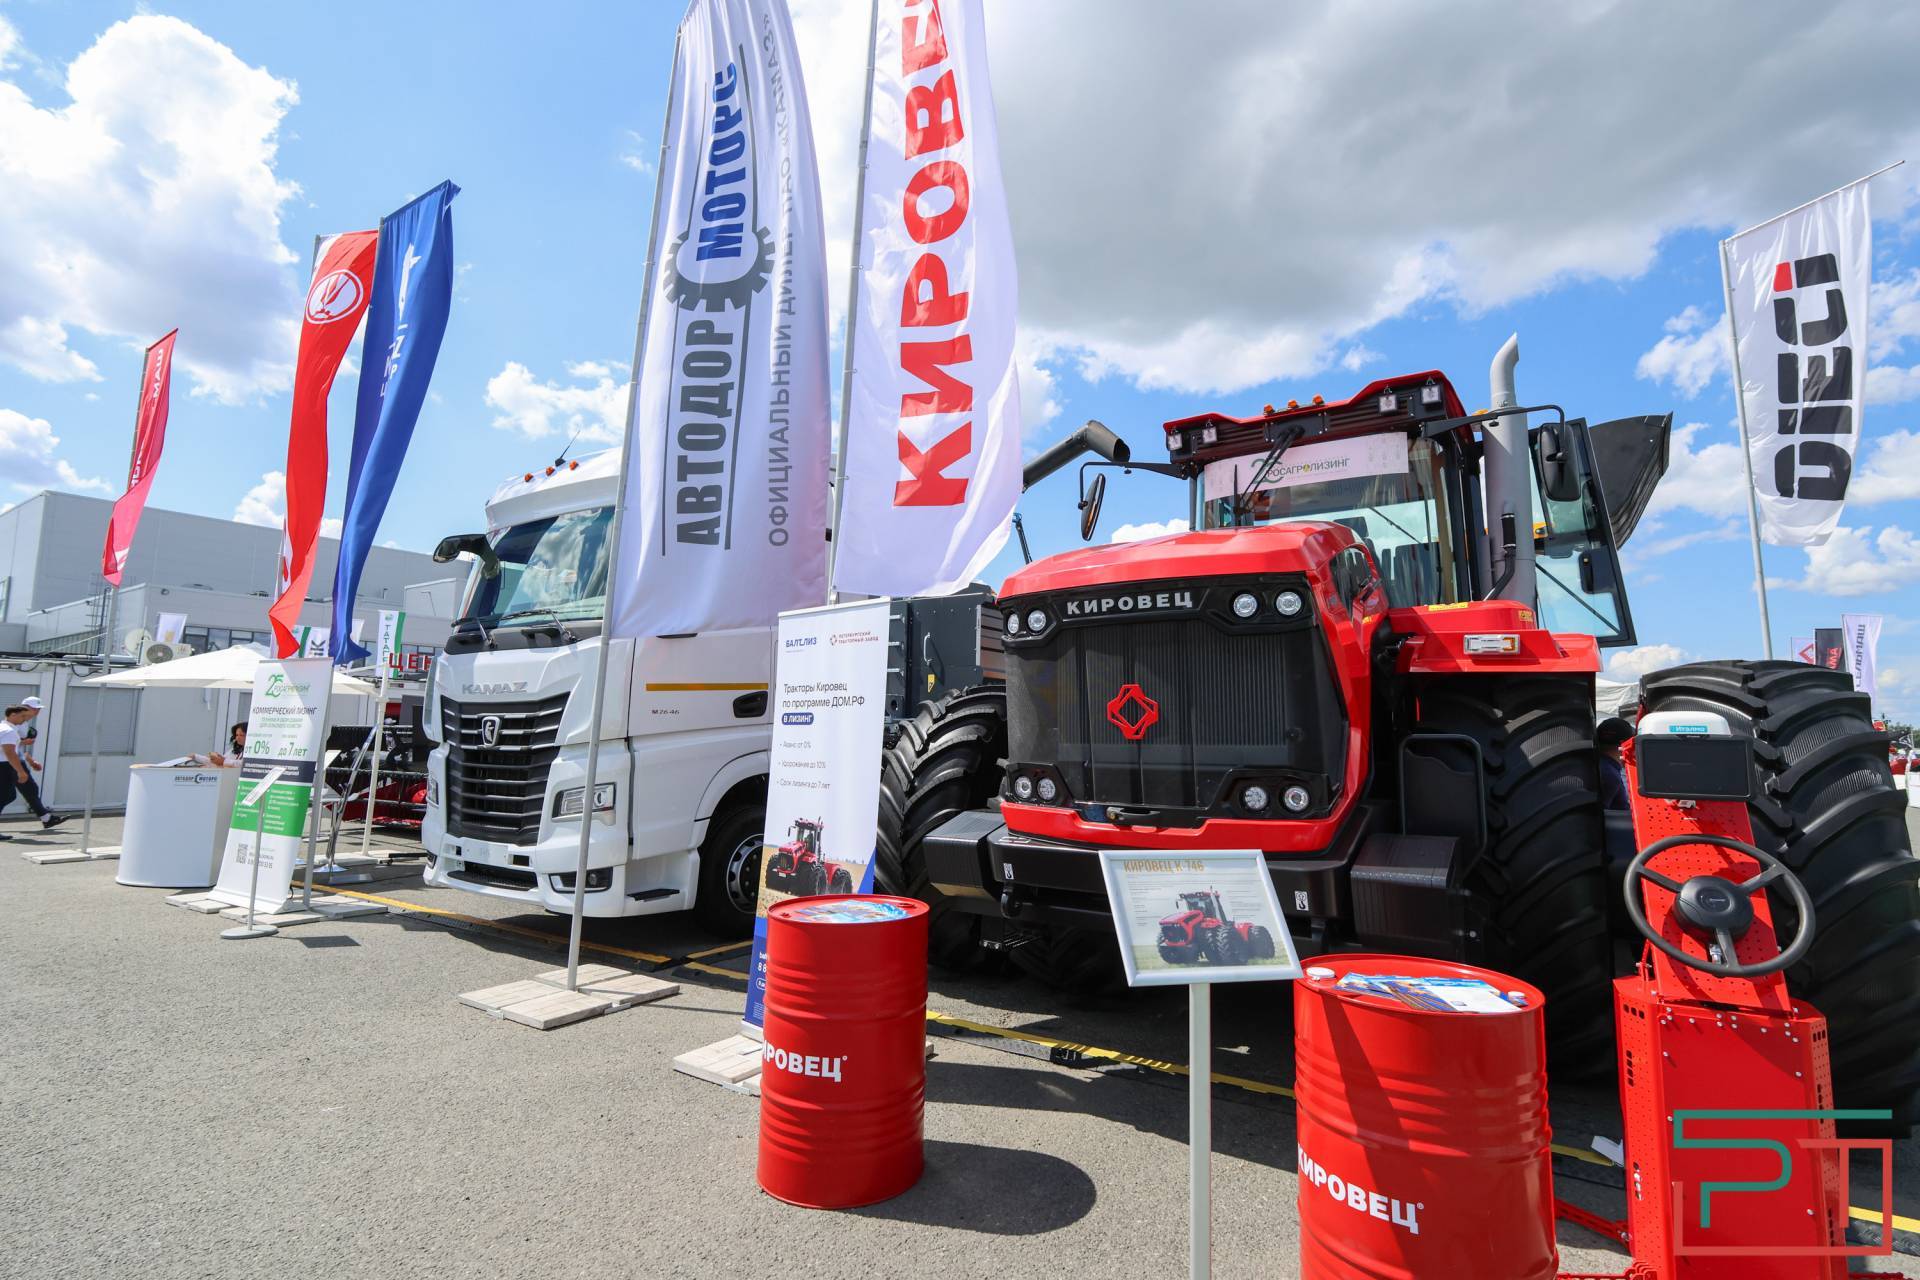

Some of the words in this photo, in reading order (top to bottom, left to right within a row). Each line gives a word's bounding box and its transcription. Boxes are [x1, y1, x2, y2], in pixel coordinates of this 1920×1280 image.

[695, 61, 747, 262] МОТОРС
[893, 0, 973, 507] КИРОВЕ
[771, 229, 796, 315] ДИЛЕР
[1773, 252, 1854, 502] DIECI
[676, 319, 734, 547] АВТОДОР
[767, 323, 793, 547] ОФИЦИАЛЬНЫЙ
[1066, 591, 1193, 616] КИРОВЕЦ
[461, 681, 528, 695] KAMAZ
[782, 699, 791, 708] по
[791, 699, 831, 709] программе
[831, 695, 865, 708] ДОМ.РФ
[783, 683, 815, 694] Тракторы
[816, 682, 848, 693] Кировец
[253, 740, 270, 755] 0%
[288, 742, 294, 755] 7
[1123, 859, 1174, 874] КИРОВЕЦ
[763, 1039, 842, 1083] РОВЕЦ
